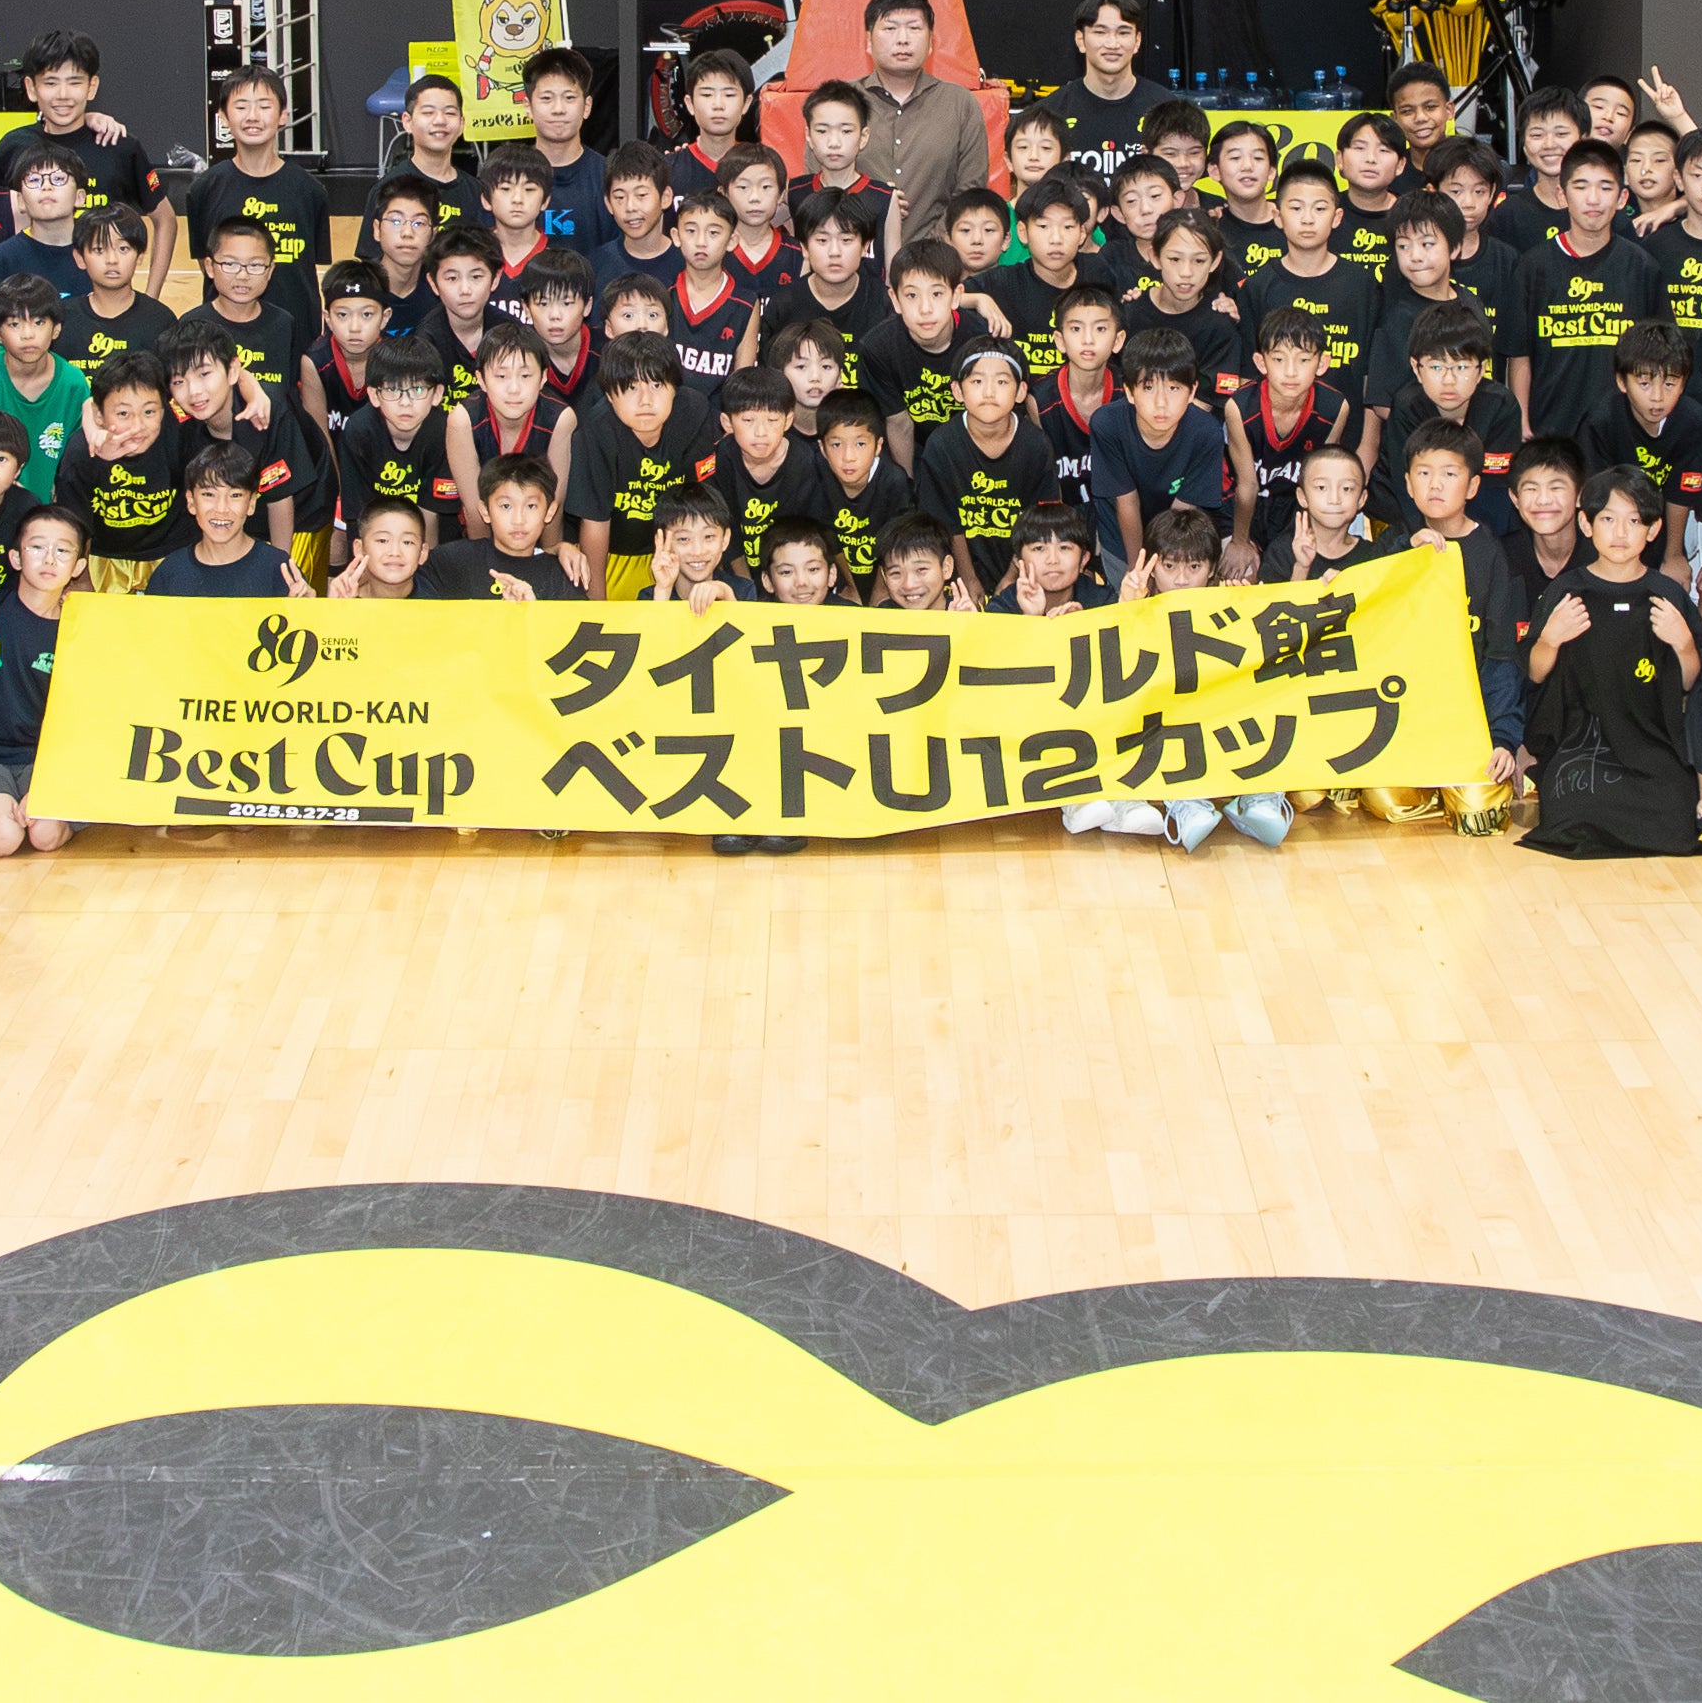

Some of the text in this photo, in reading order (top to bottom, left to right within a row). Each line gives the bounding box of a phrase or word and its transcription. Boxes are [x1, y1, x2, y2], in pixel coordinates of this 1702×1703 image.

[1353, 253, 1390, 263] WORLD-
[1667, 284, 1680, 294] RE
[1548, 302, 1624, 314] TIRE WORLD-KAN
[1671, 296, 1698, 318] st
[1538, 313, 1587, 338] Best
[1324, 335, 1359, 365] up
[321, 638, 358, 646] SENDAI
[545, 591, 1359, 716] タイヤワールド館
[179, 698, 429, 724] TIRE WORLD-KAN
[542, 675, 1407, 819] ベストU12カップ
[120, 724, 475, 816] Best Cup
[228, 803, 360, 822] 2025.9.27-28
